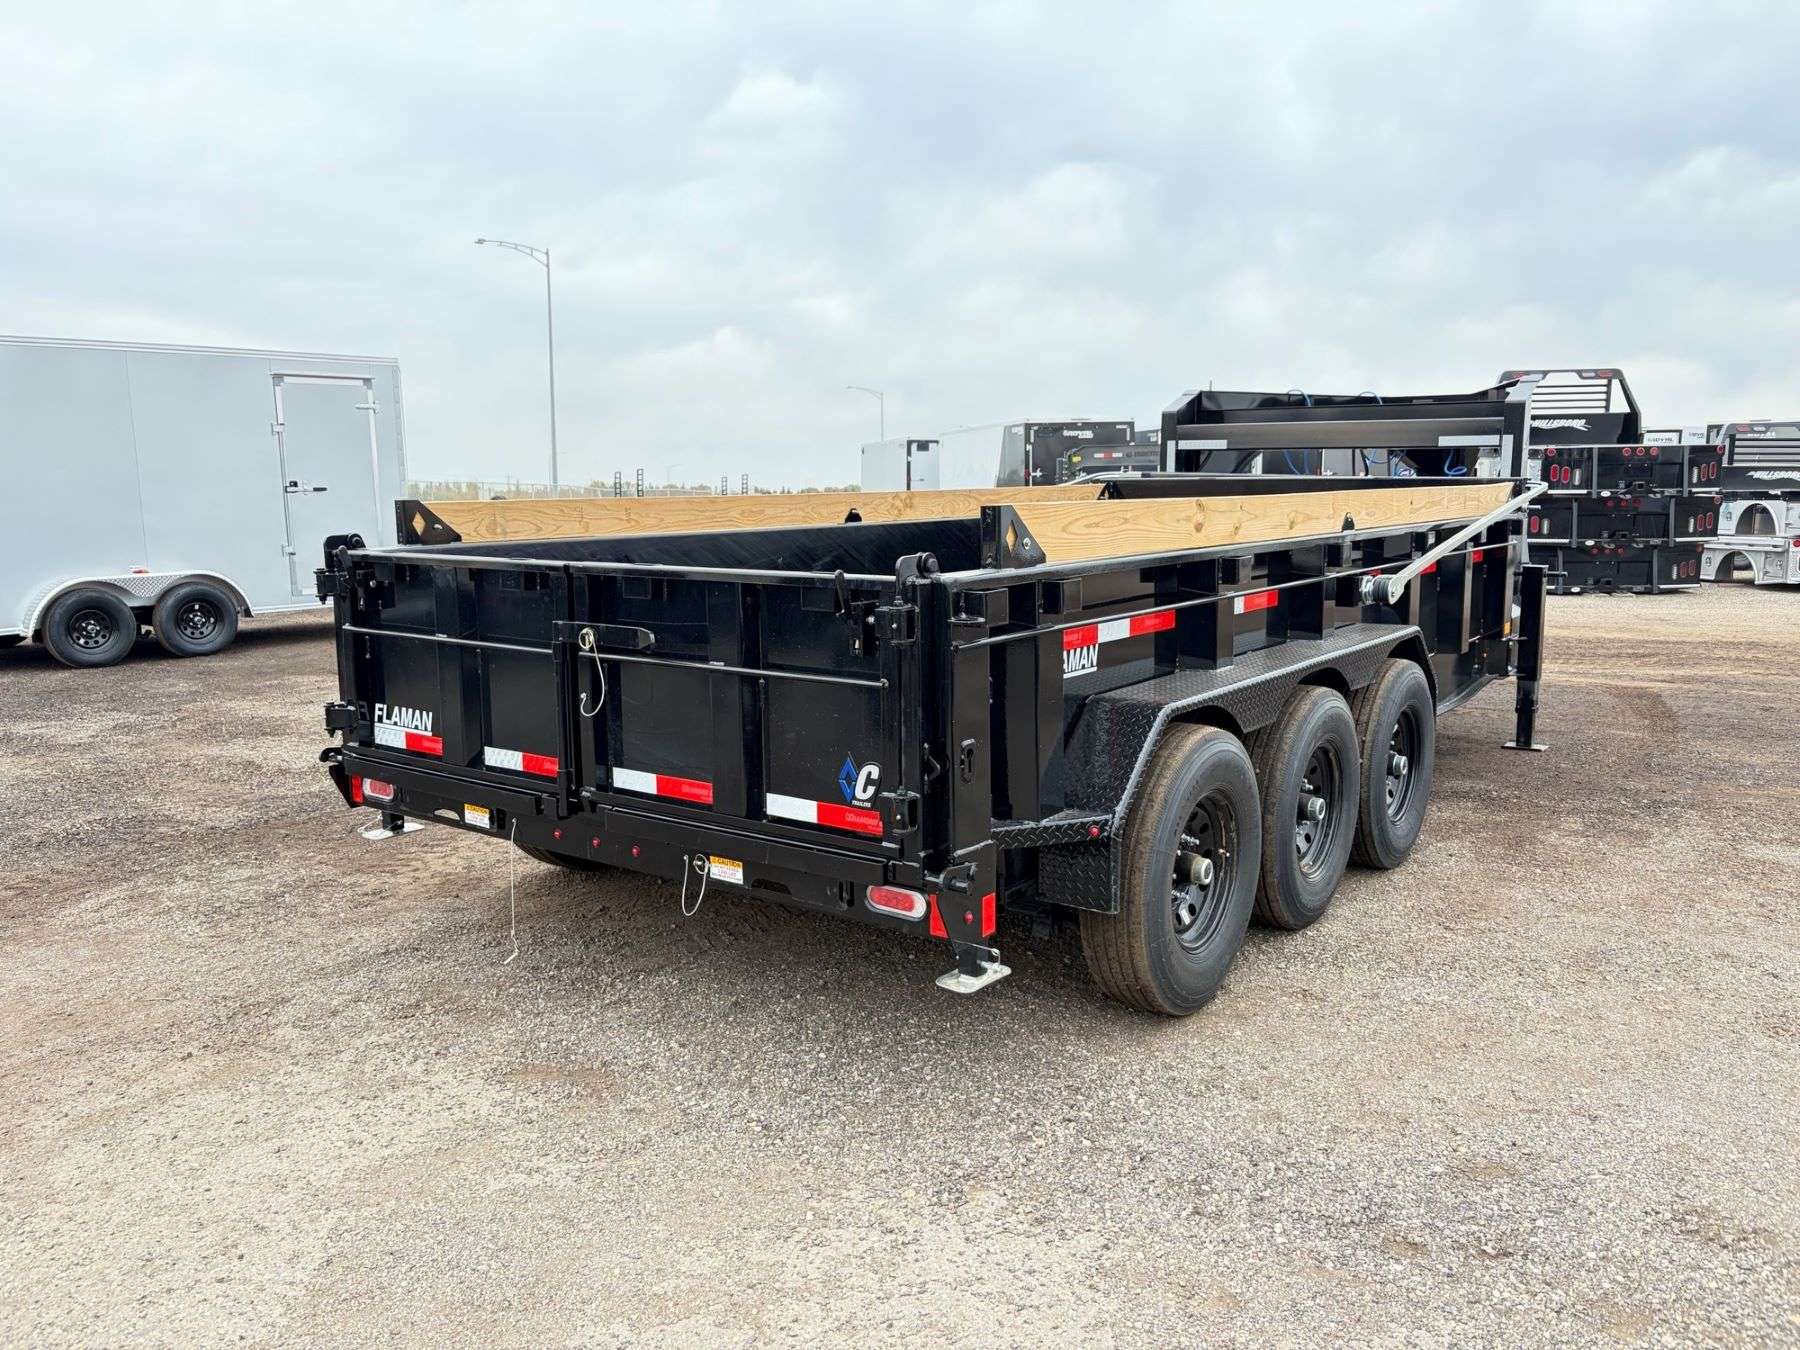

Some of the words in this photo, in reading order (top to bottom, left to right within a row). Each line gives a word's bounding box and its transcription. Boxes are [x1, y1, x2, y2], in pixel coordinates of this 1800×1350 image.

[1063, 643, 1099, 672] AMAN
[374, 703, 433, 732] FLAMAN
[854, 764, 880, 800] C
